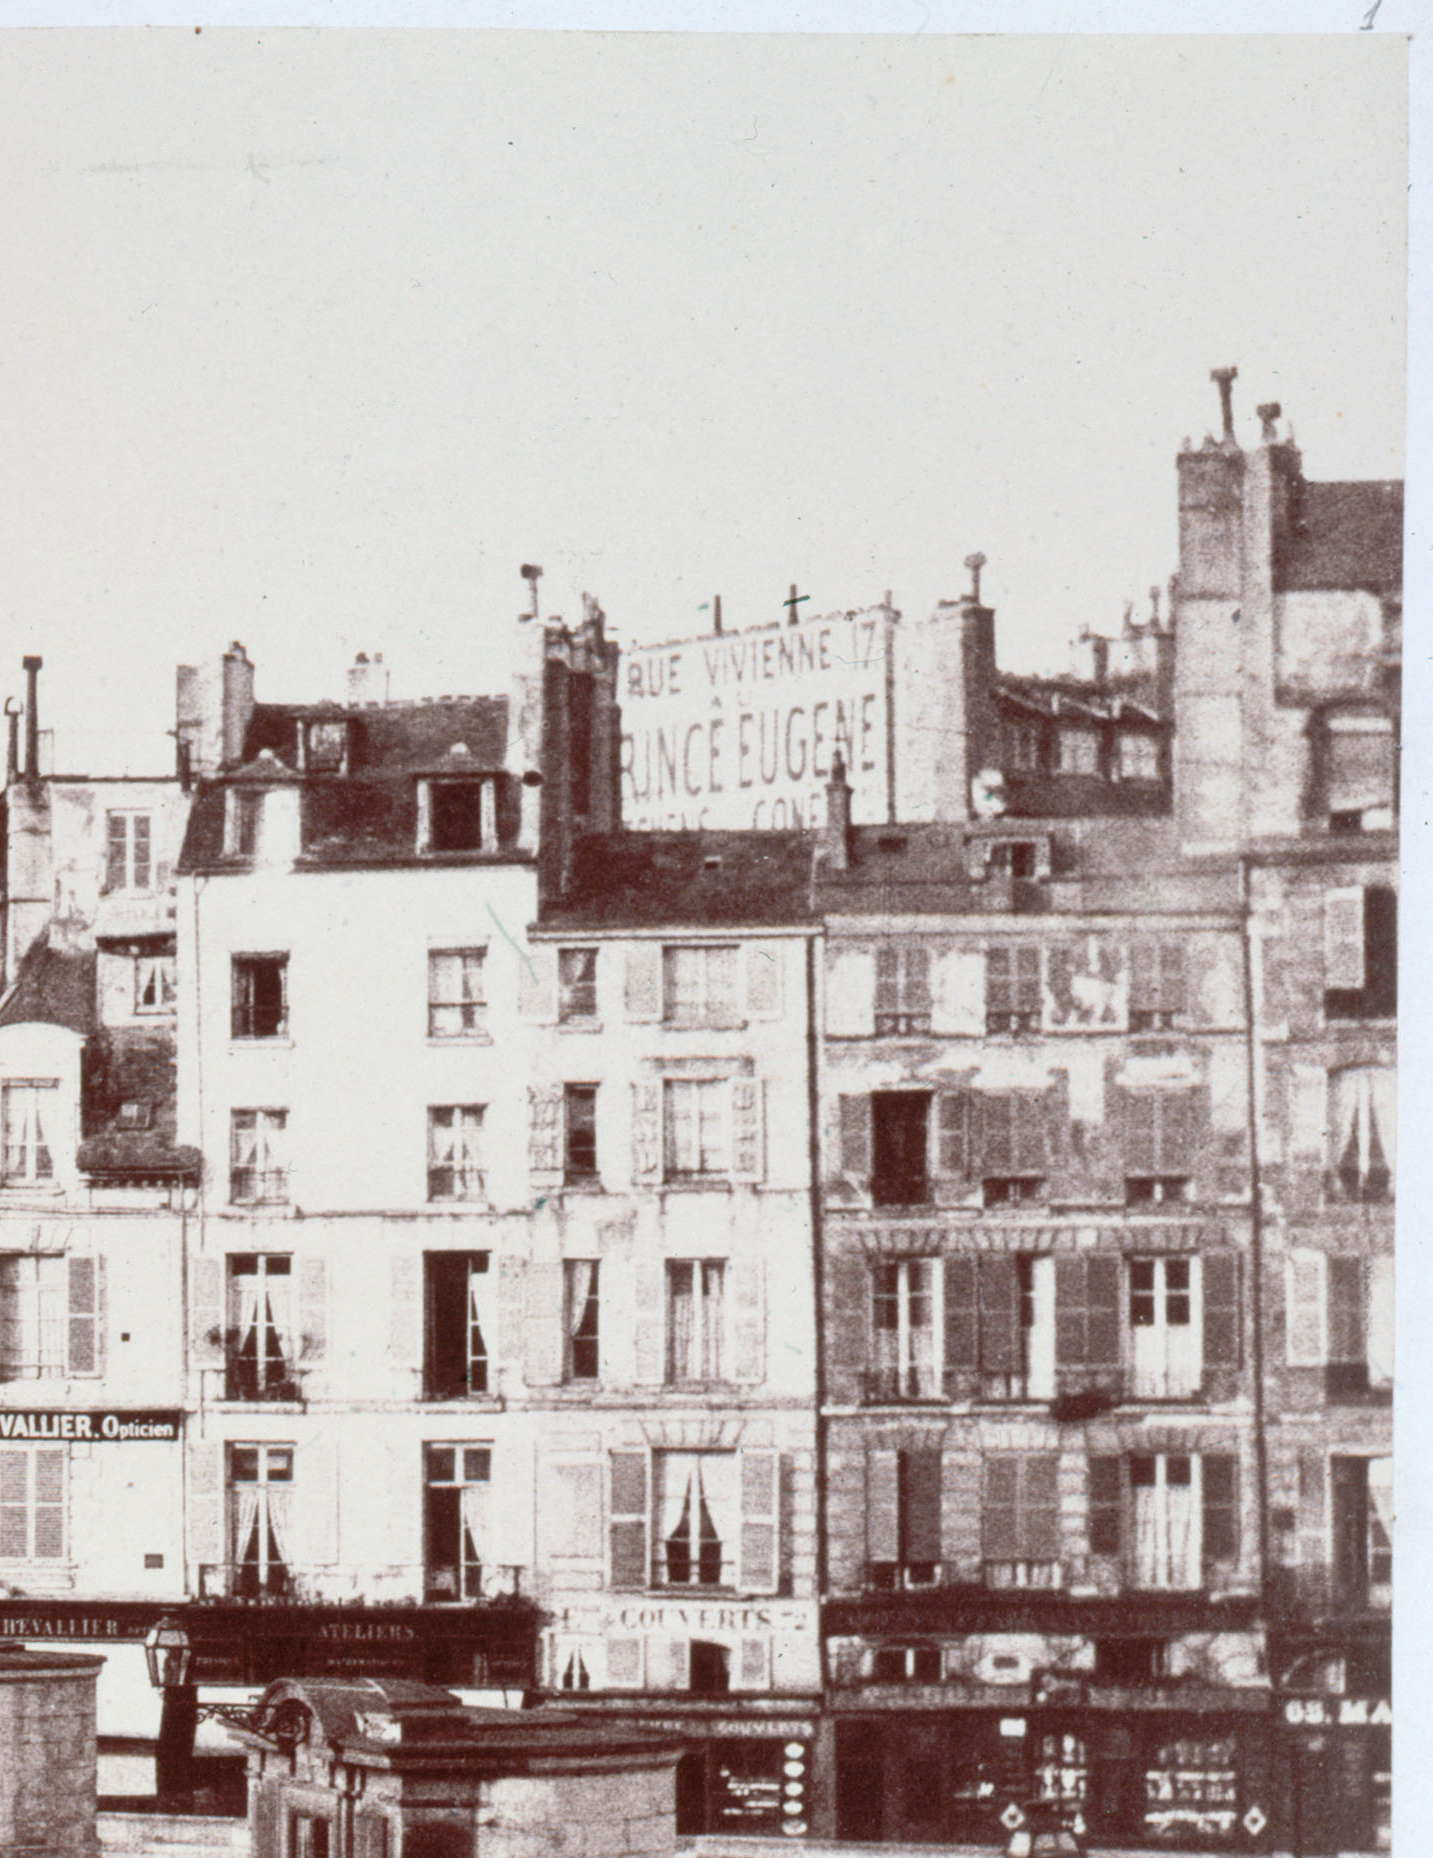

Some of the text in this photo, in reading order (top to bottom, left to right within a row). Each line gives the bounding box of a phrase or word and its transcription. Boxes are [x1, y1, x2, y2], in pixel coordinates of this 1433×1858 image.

[627, 652, 682, 698] RUE
[702, 628, 831, 687] VIVIENNE
[620, 692, 876, 803] RINCE EUGENE
[101, 1414, 174, 1440] Opticien
[619, 1607, 773, 1631] COUVERTS
